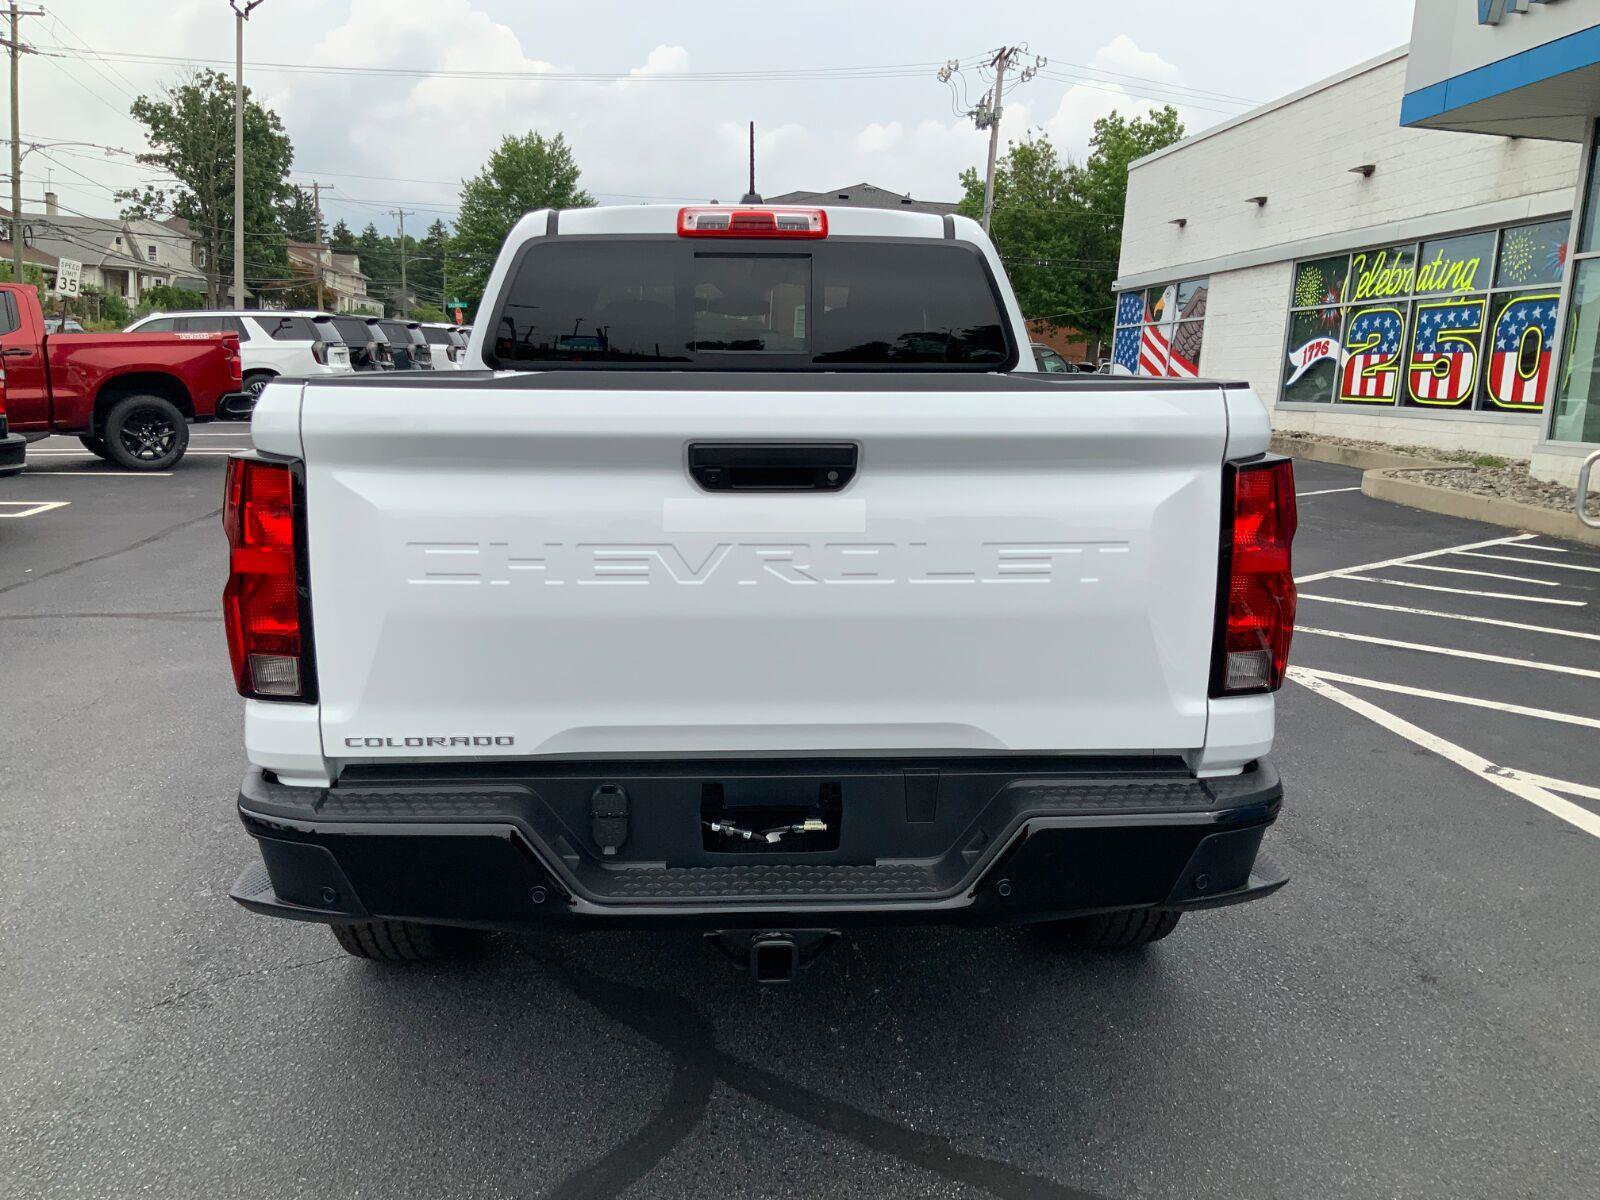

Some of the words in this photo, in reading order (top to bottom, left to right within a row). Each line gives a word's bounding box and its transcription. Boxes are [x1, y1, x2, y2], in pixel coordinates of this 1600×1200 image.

[60, 261, 80, 271] SPEED
[61, 269, 78, 278] LIMIT
[59, 276, 77, 293] 35
[1340, 248, 1481, 315] Celebrating
[1301, 339, 1331, 367] 1776
[1339, 293, 1562, 410] 250
[405, 540, 1130, 585] CHEVROLET
[343, 735, 515, 749] COLORADO
